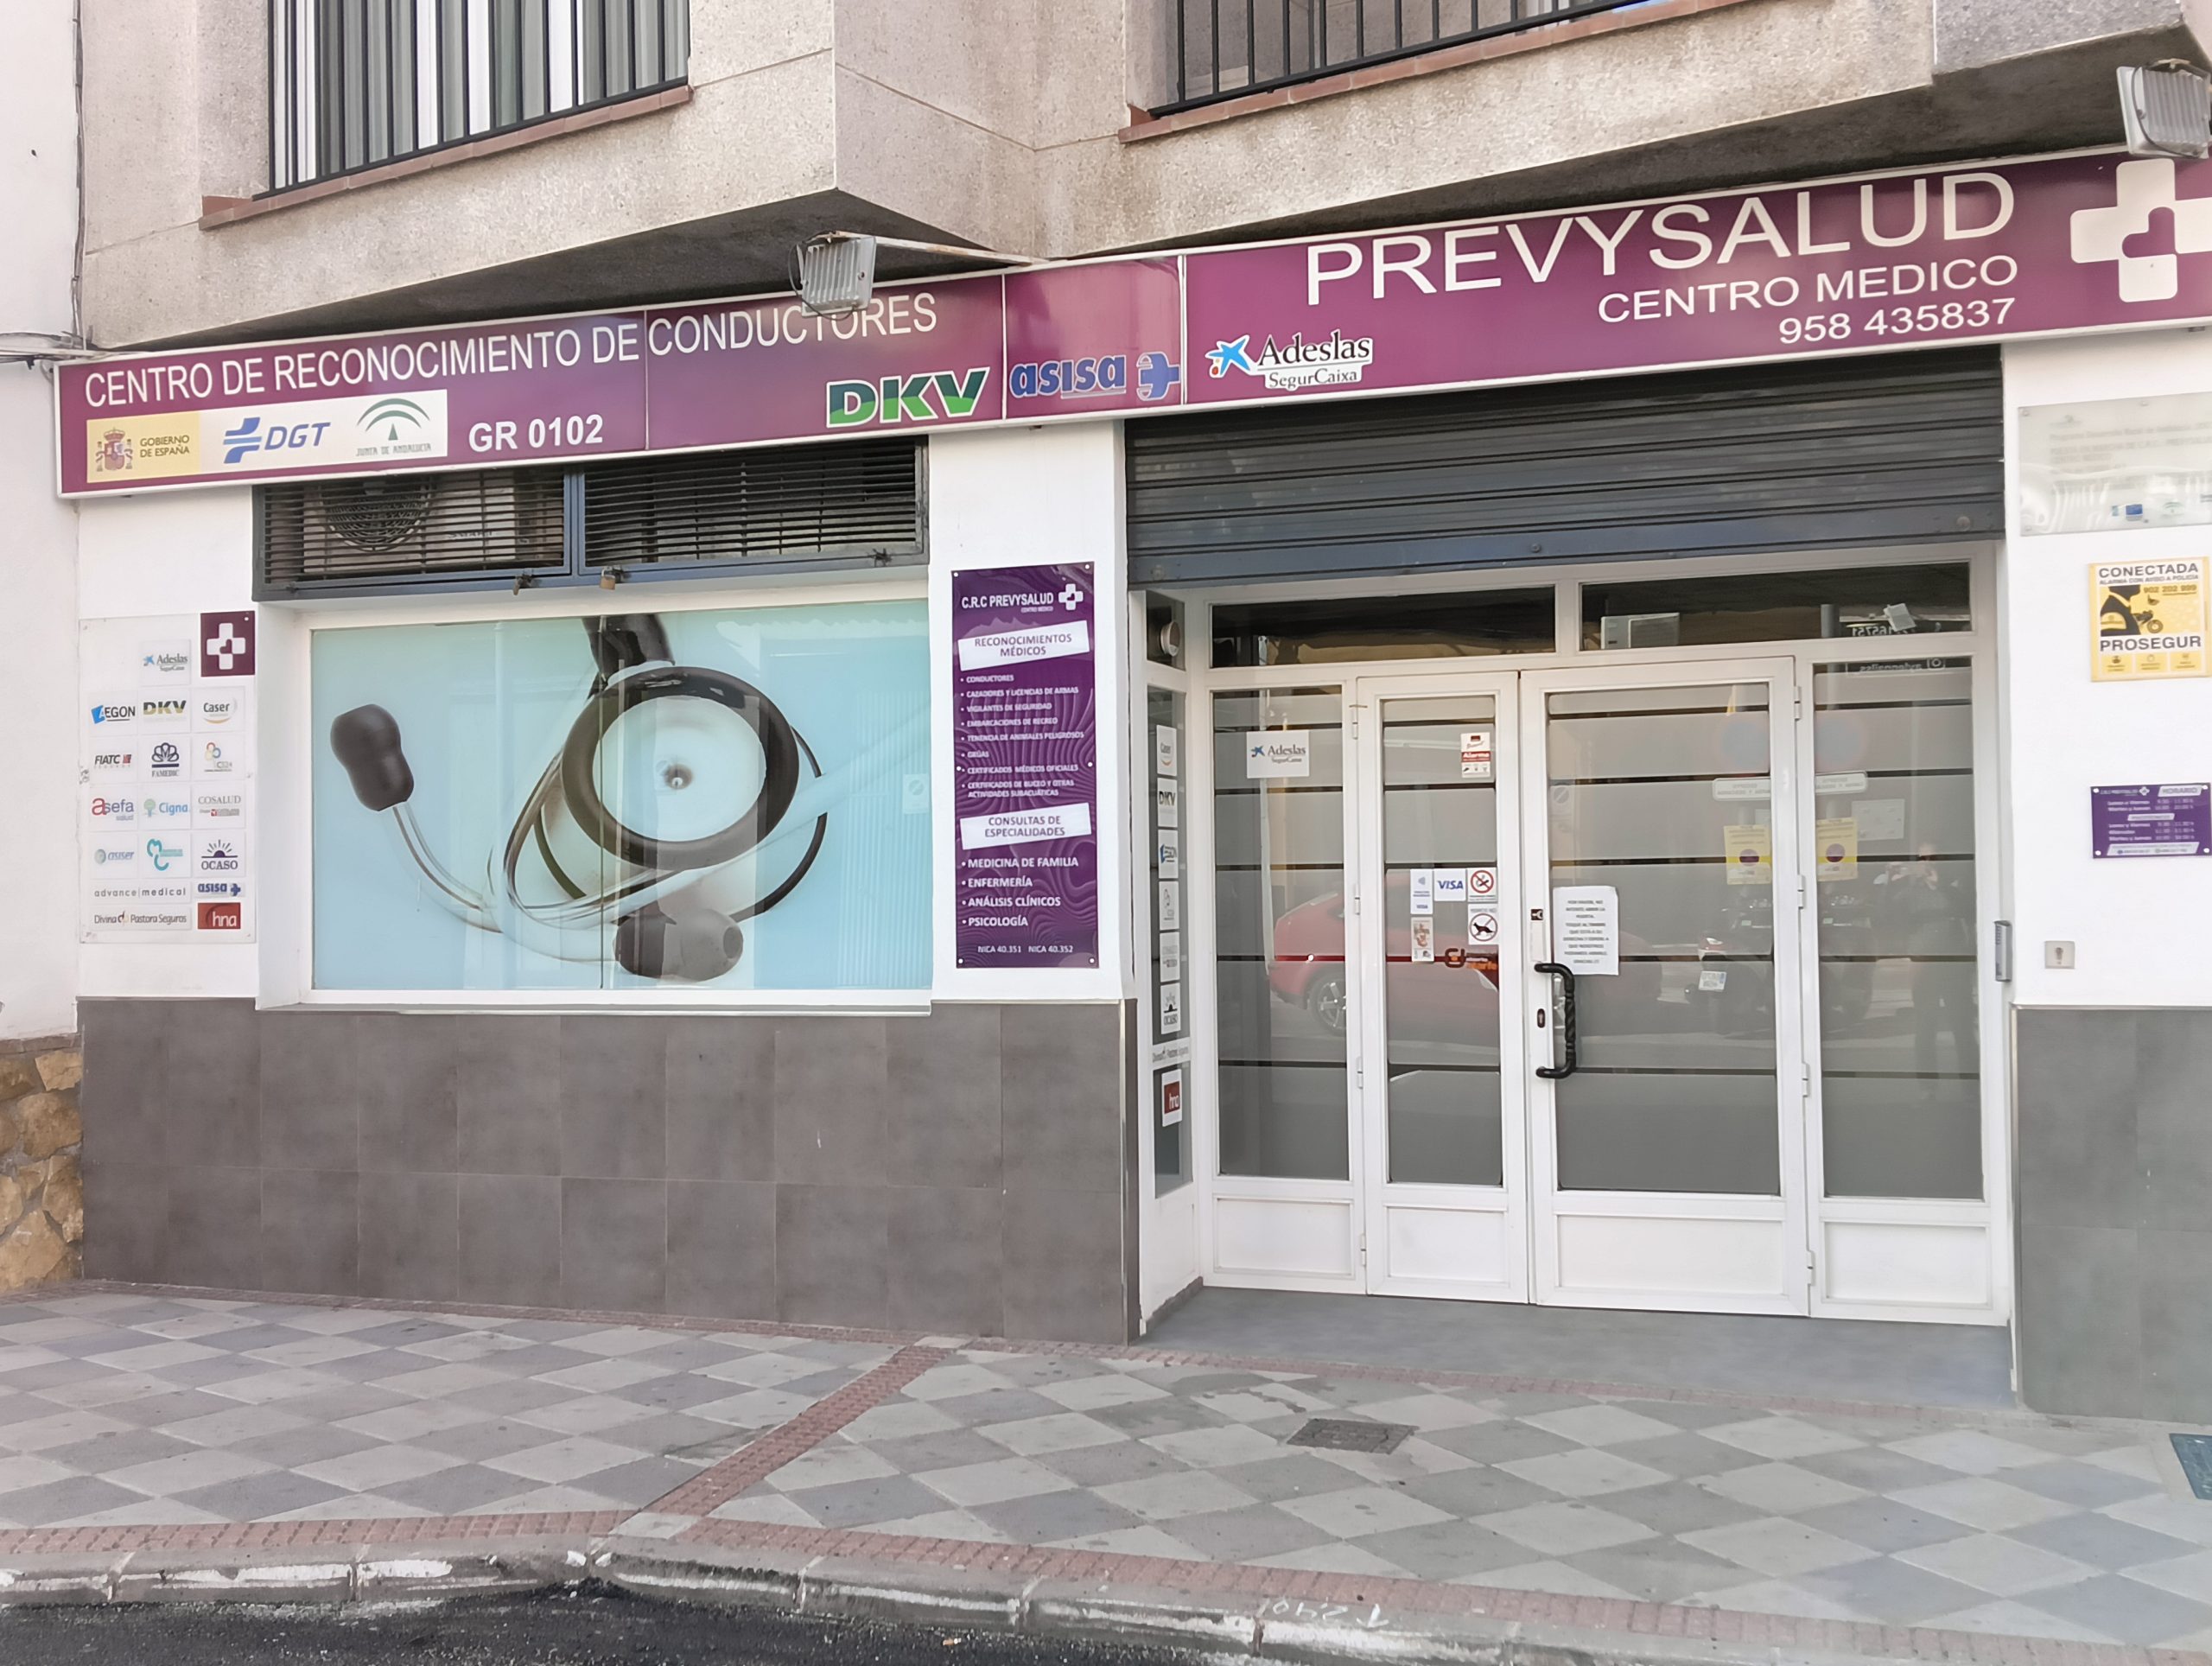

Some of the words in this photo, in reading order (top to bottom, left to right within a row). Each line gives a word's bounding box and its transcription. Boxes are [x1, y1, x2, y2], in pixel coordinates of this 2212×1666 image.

[1307, 172, 2014, 306] PREVYSALUD
[1598, 277, 1799, 323] CENTRO
[1817, 255, 2018, 302] MEDICO
[1778, 313, 1852, 345] 958
[1864, 297, 2016, 336] 435837
[86, 362, 213, 408] CENTRO
[222, 358, 264, 396] DE
[274, 328, 581, 391] RECONOCIMIENTO
[592, 323, 639, 363] DE
[649, 292, 937, 355] CONDUCTORES
[1257, 330, 1370, 367] Adeslas
[1009, 355, 1126, 398] asisa
[1268, 367, 1357, 391] SegurCaixa
[826, 366, 991, 429] DKV
[264, 422, 331, 450] DGT
[468, 421, 518, 452] GR
[529, 414, 603, 448] 0102
[140, 435, 190, 447] GOBIERNO
[140, 448, 152, 458] DE
[155, 444, 189, 457] ESPAÑA
[356, 447, 378, 456] JUNTA
[381, 446, 389, 455] DE
[2099, 563, 2198, 578] CONECTADA
[961, 596, 988, 608] C.R.C
[989, 592, 1054, 607] PREVYSALUD
[975, 633, 1072, 647] RECONOCIMIENTOS
[2100, 636, 2201, 652] PROSEGUR
[156, 653, 188, 664] Adeslas
[1000, 645, 1046, 658] MÉDICOS
[143, 700, 187, 715] DKV
[203, 703, 231, 713] Caser
[1268, 744, 1306, 756] Adeslas
[95, 754, 121, 765] FIATC
[198, 795, 241, 804] COSALUD
[1159, 791, 1176, 805] DKV
[92, 798, 134, 816] asefa
[159, 802, 188, 816] Cigna
[988, 816, 1046, 826] CONSULTAS
[1048, 816, 1061, 824] DE
[985, 827, 1065, 837] ESPECIALIDADES
[201, 860, 238, 870] OCASO
[968, 858, 1020, 868] MEDICINA
[1021, 858, 1035, 867] DE
[1037, 857, 1079, 867] FAMILIA
[198, 883, 227, 893] asisa
[968, 875, 1033, 887] ENFERMERÍA
[1437, 881, 1464, 889] VISA
[94, 888, 137, 897] advance
[142, 887, 186, 896] medical
[968, 894, 1013, 906] ANÁLISIS
[1015, 894, 1061, 906] CLÍNICOS
[94, 914, 117, 925] Divina
[130, 913, 157, 924] Pastora
[159, 914, 187, 925] Seguros
[212, 912, 237, 927] hna
[968, 914, 1028, 926] PSICOLOGÍA
